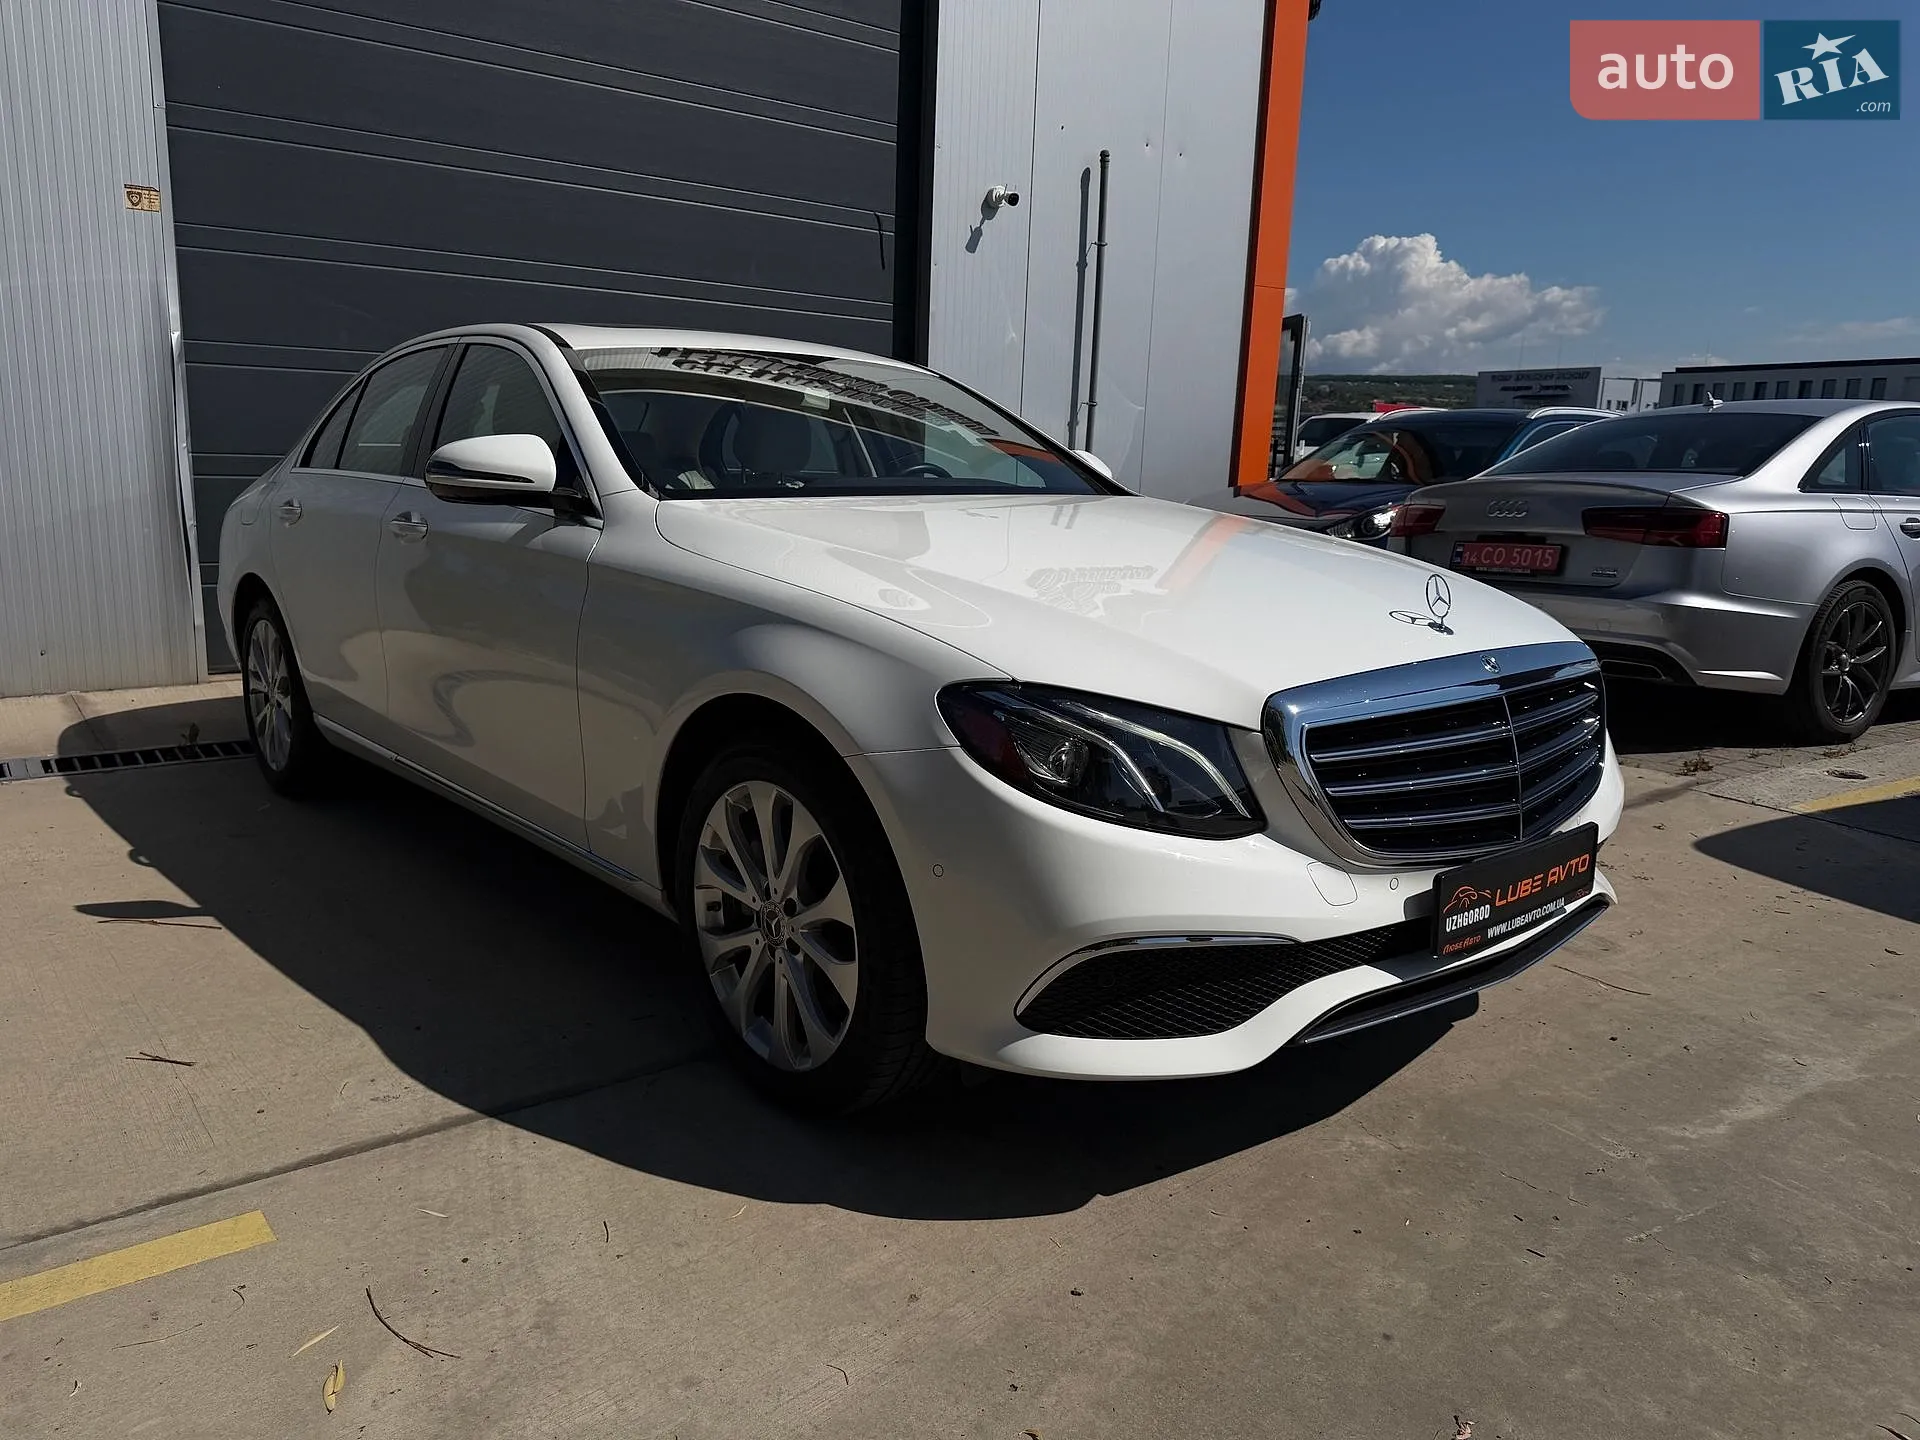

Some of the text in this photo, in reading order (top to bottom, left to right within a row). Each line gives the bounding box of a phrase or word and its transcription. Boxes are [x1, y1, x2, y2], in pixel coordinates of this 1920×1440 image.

[1510, 548, 1554, 567] 5015
[1495, 873, 1544, 907] LUBE
[1546, 853, 1590, 888] AVTO
[1445, 904, 1491, 933] UZHGOROD
[1487, 896, 1566, 939] WWW.LUBEAVTO.COM.UA
